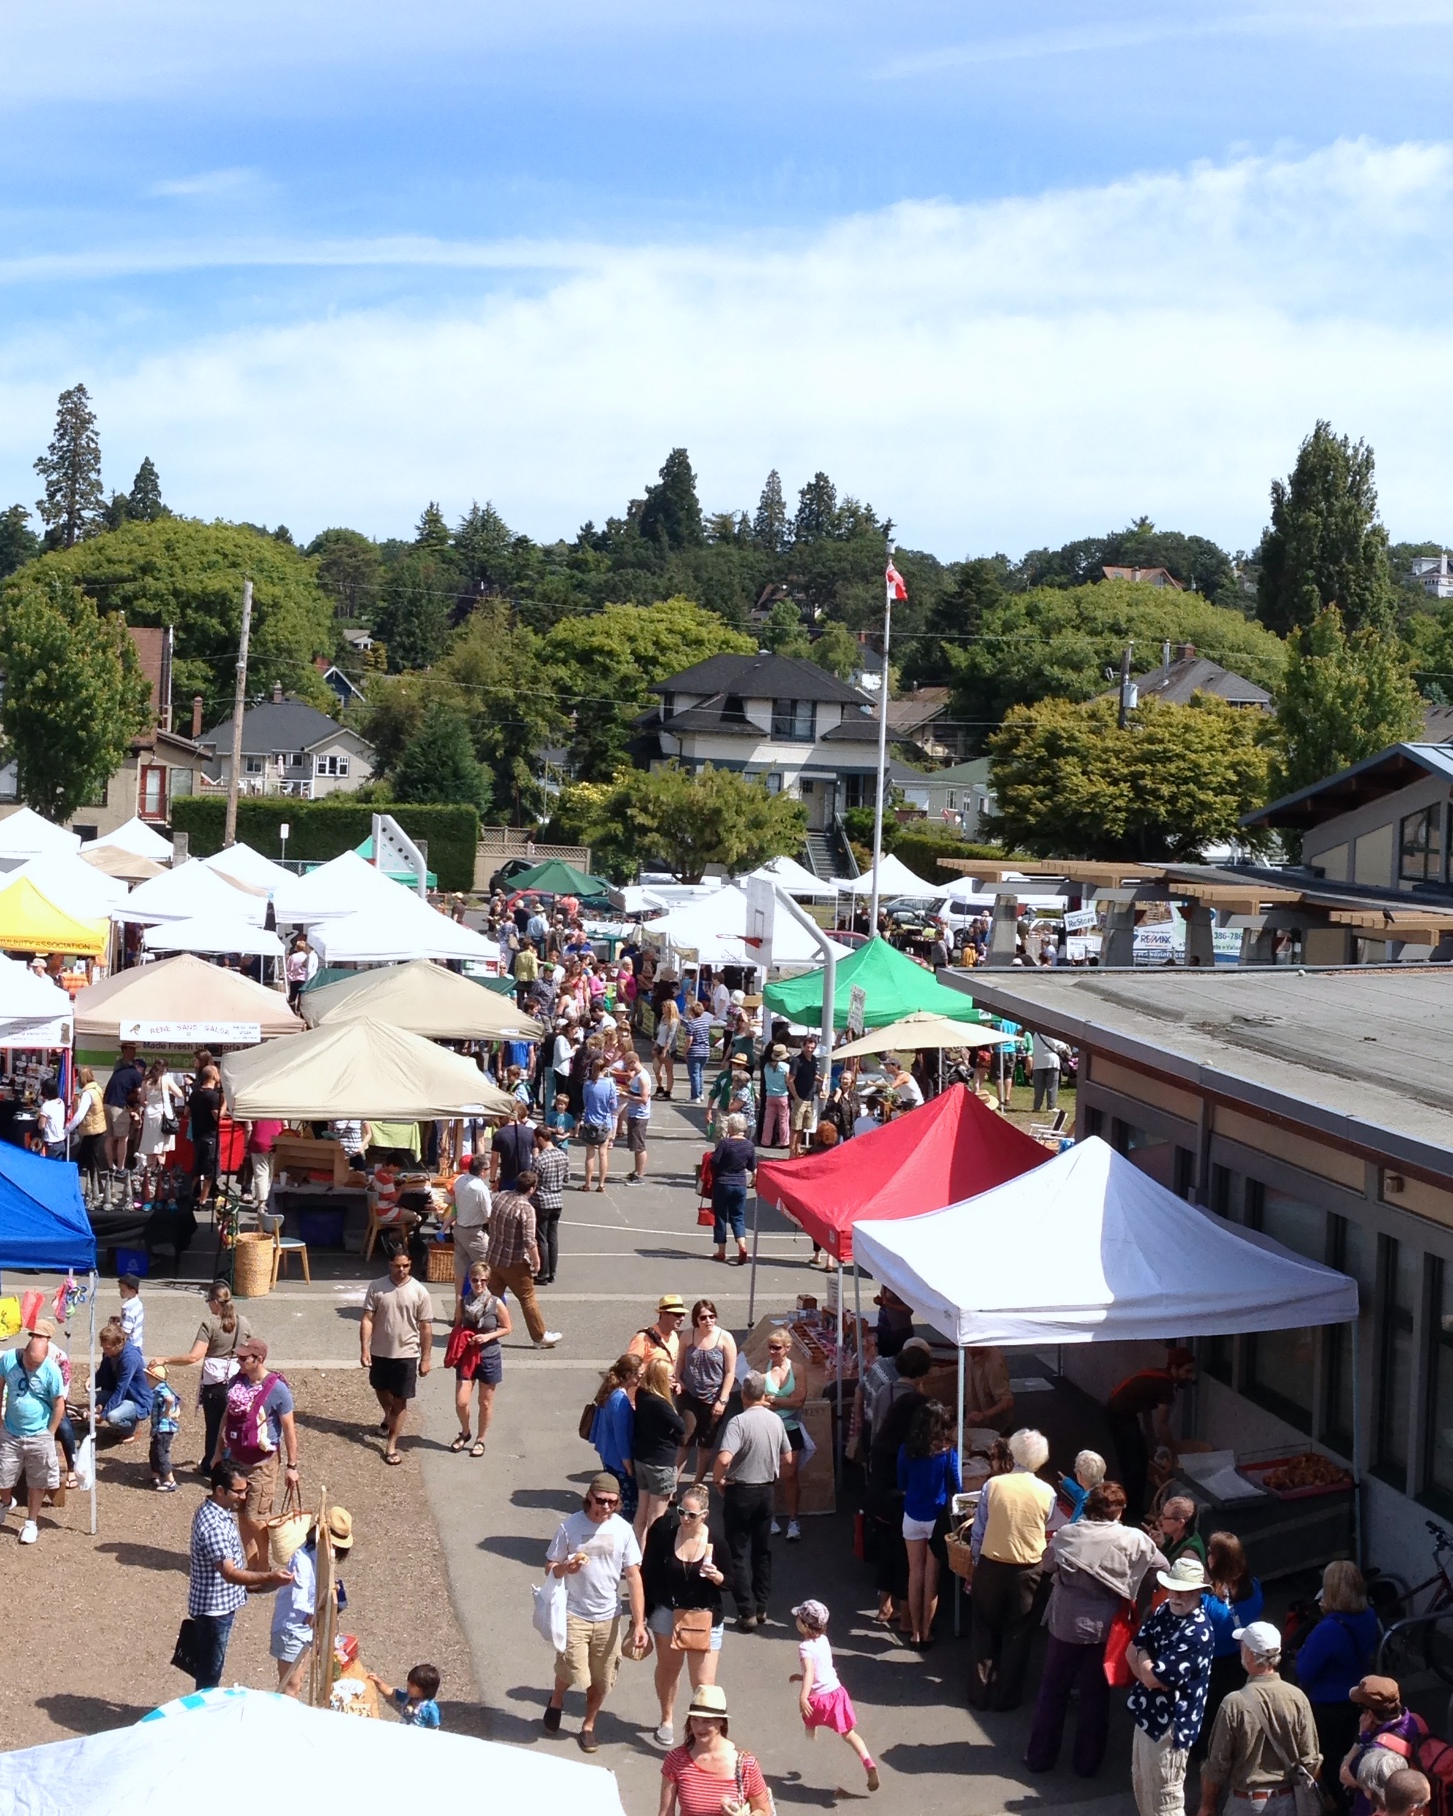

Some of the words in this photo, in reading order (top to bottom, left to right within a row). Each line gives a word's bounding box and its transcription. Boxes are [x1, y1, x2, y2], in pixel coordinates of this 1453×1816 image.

[1140, 935, 1172, 944] RE/MAX
[35, 941, 91, 950] ASSOCIATION
[168, 1042, 193, 1050] Fresh
